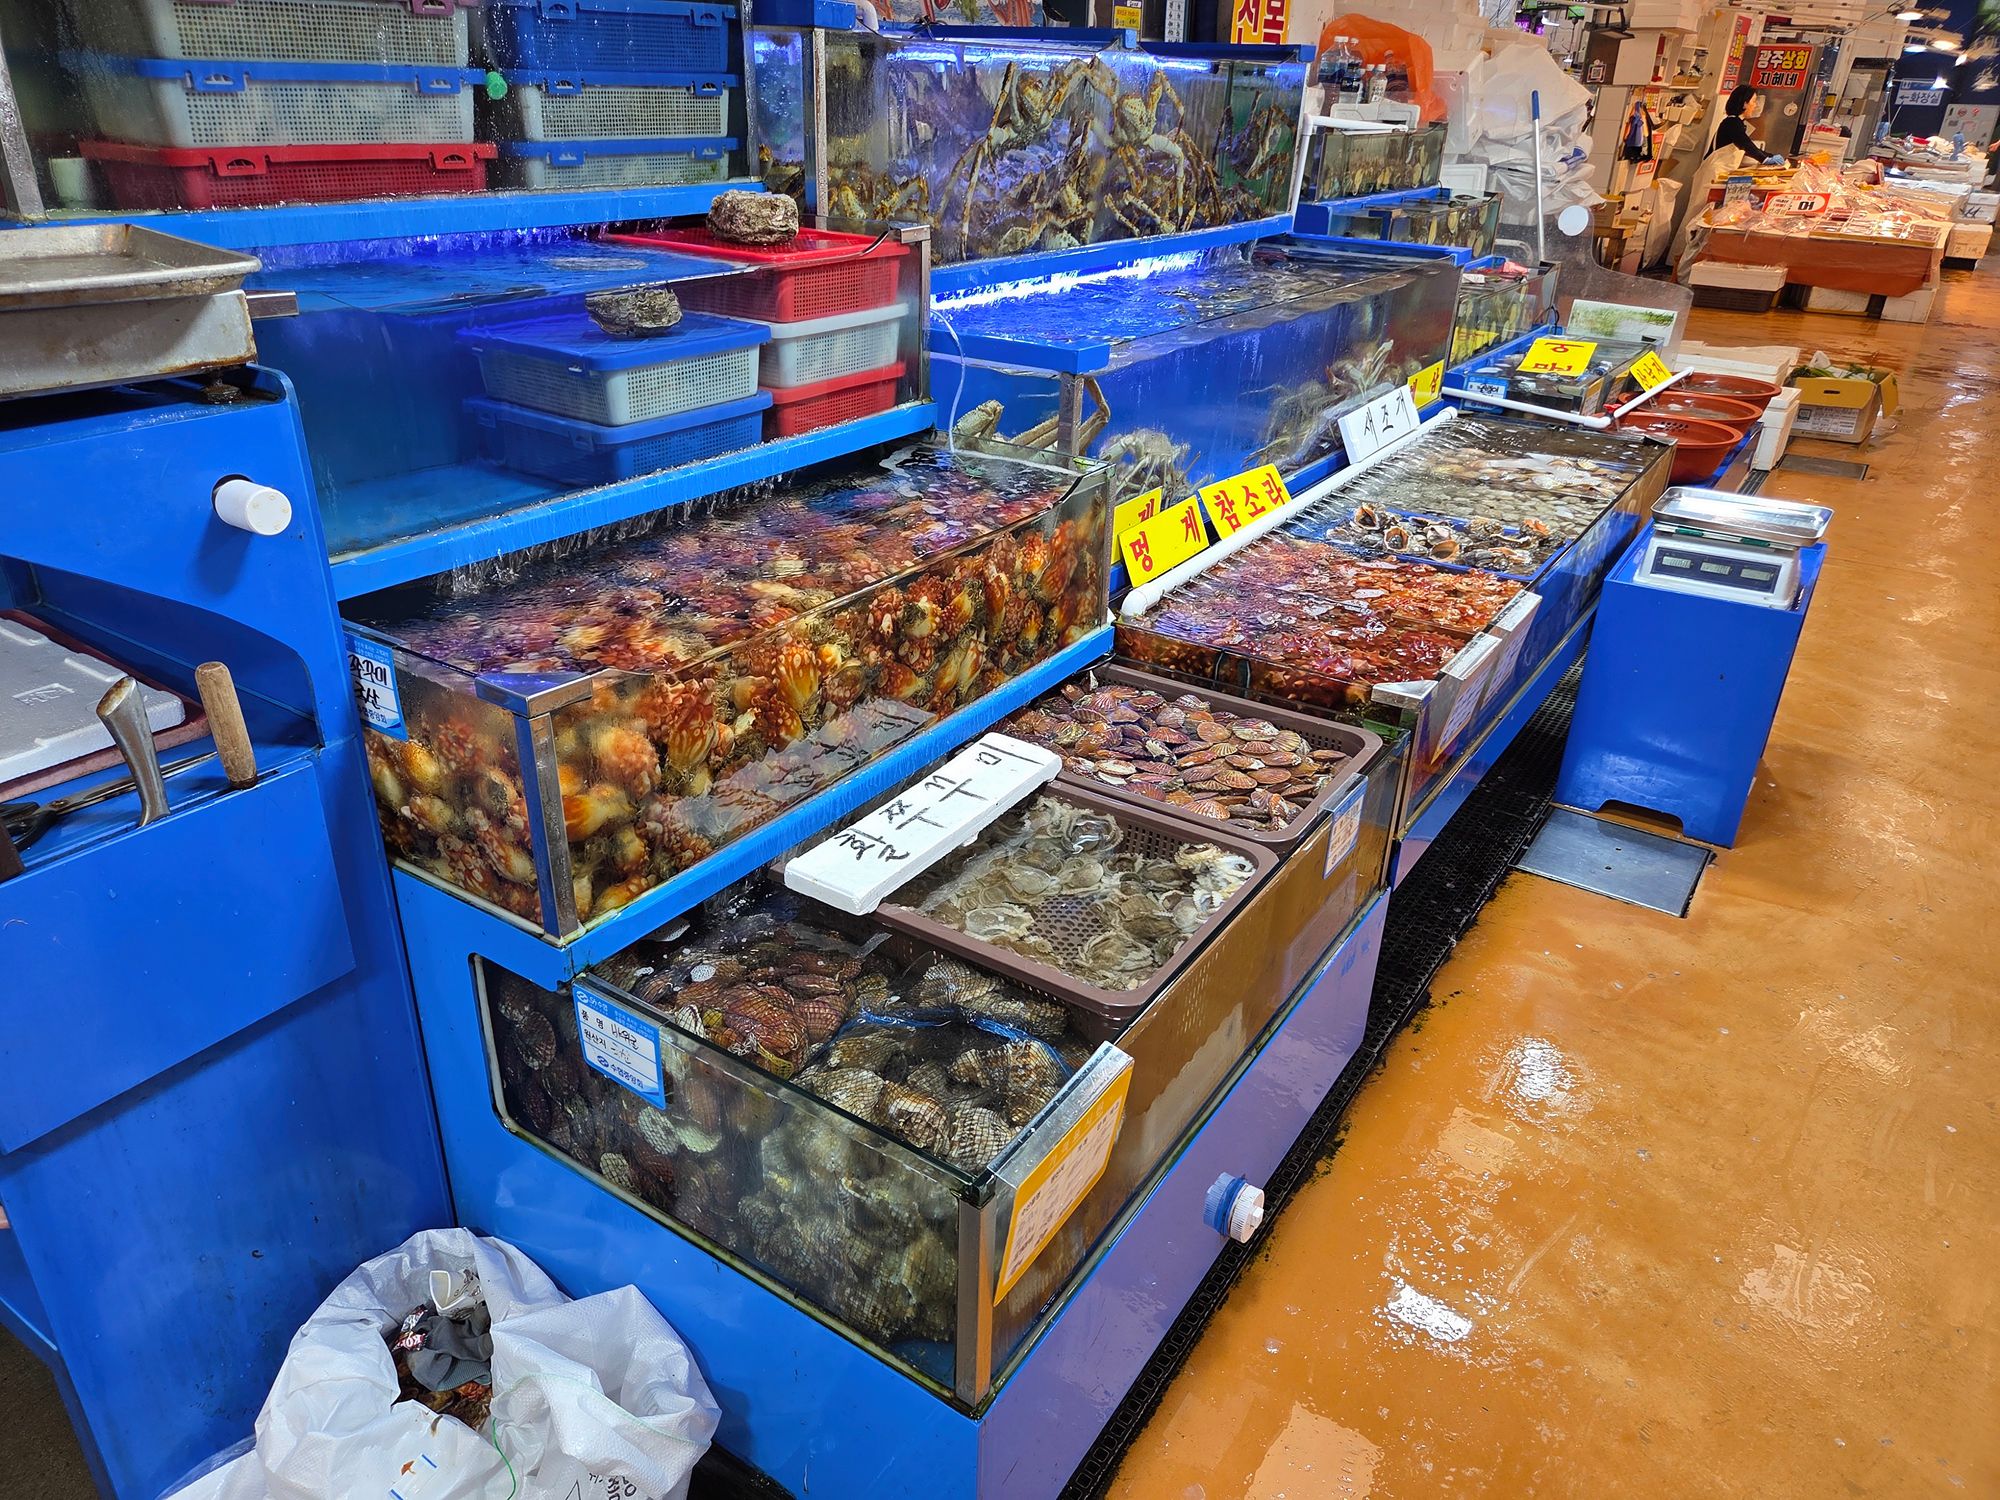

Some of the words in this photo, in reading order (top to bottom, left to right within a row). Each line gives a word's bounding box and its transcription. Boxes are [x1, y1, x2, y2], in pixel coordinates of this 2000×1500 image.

[1757, 49, 1810, 71] 광주상회
[1909, 91, 1940, 104] 화장실
[1213, 472, 1284, 533] 참소라
